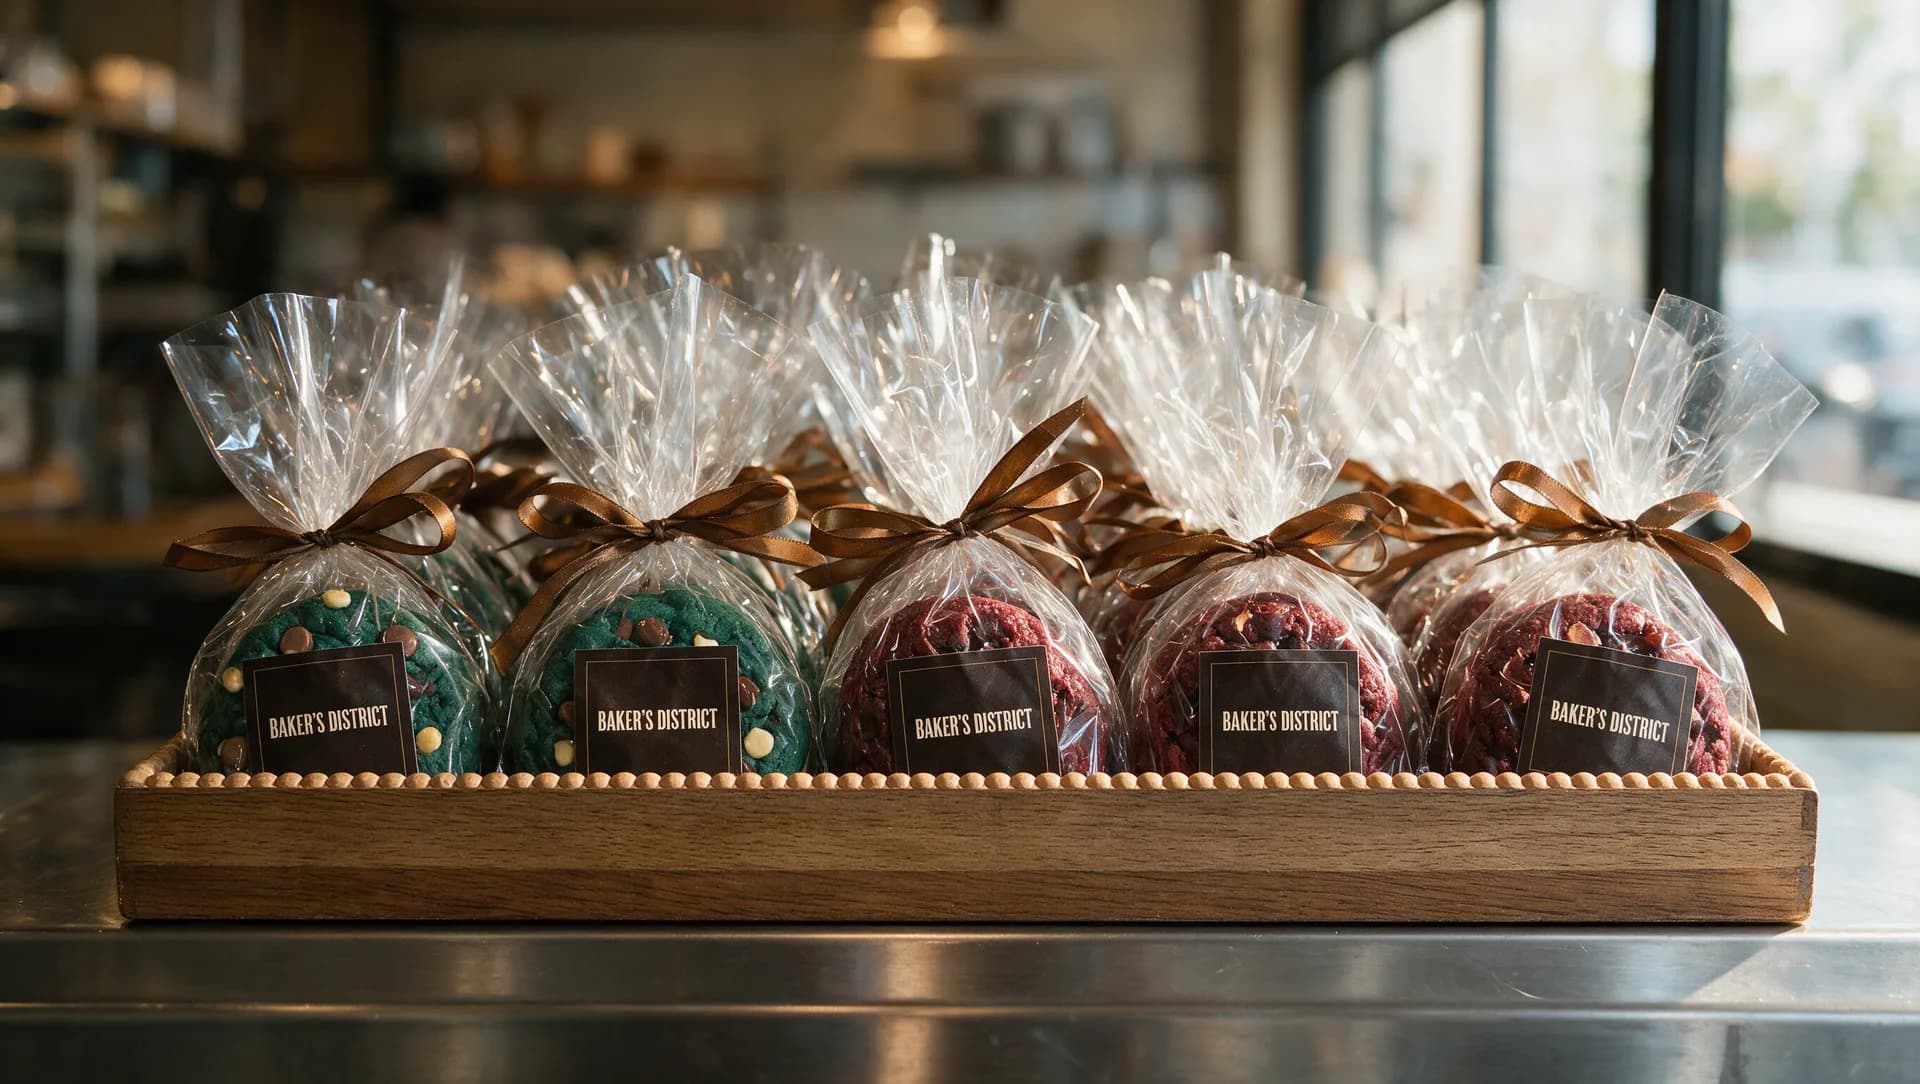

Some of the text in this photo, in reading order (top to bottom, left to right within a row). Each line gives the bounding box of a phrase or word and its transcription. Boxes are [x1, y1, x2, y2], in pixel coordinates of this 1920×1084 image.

[269, 704, 388, 739] BAKER'S DISTRICT
[598, 707, 718, 732] BAKER'S DISTRICT
[915, 707, 1033, 740] BAKER'S DISTRICT
[1222, 709, 1340, 732] BAKER'S DISTRICT
[1550, 699, 1671, 744] BAKER'S DISTRICT
